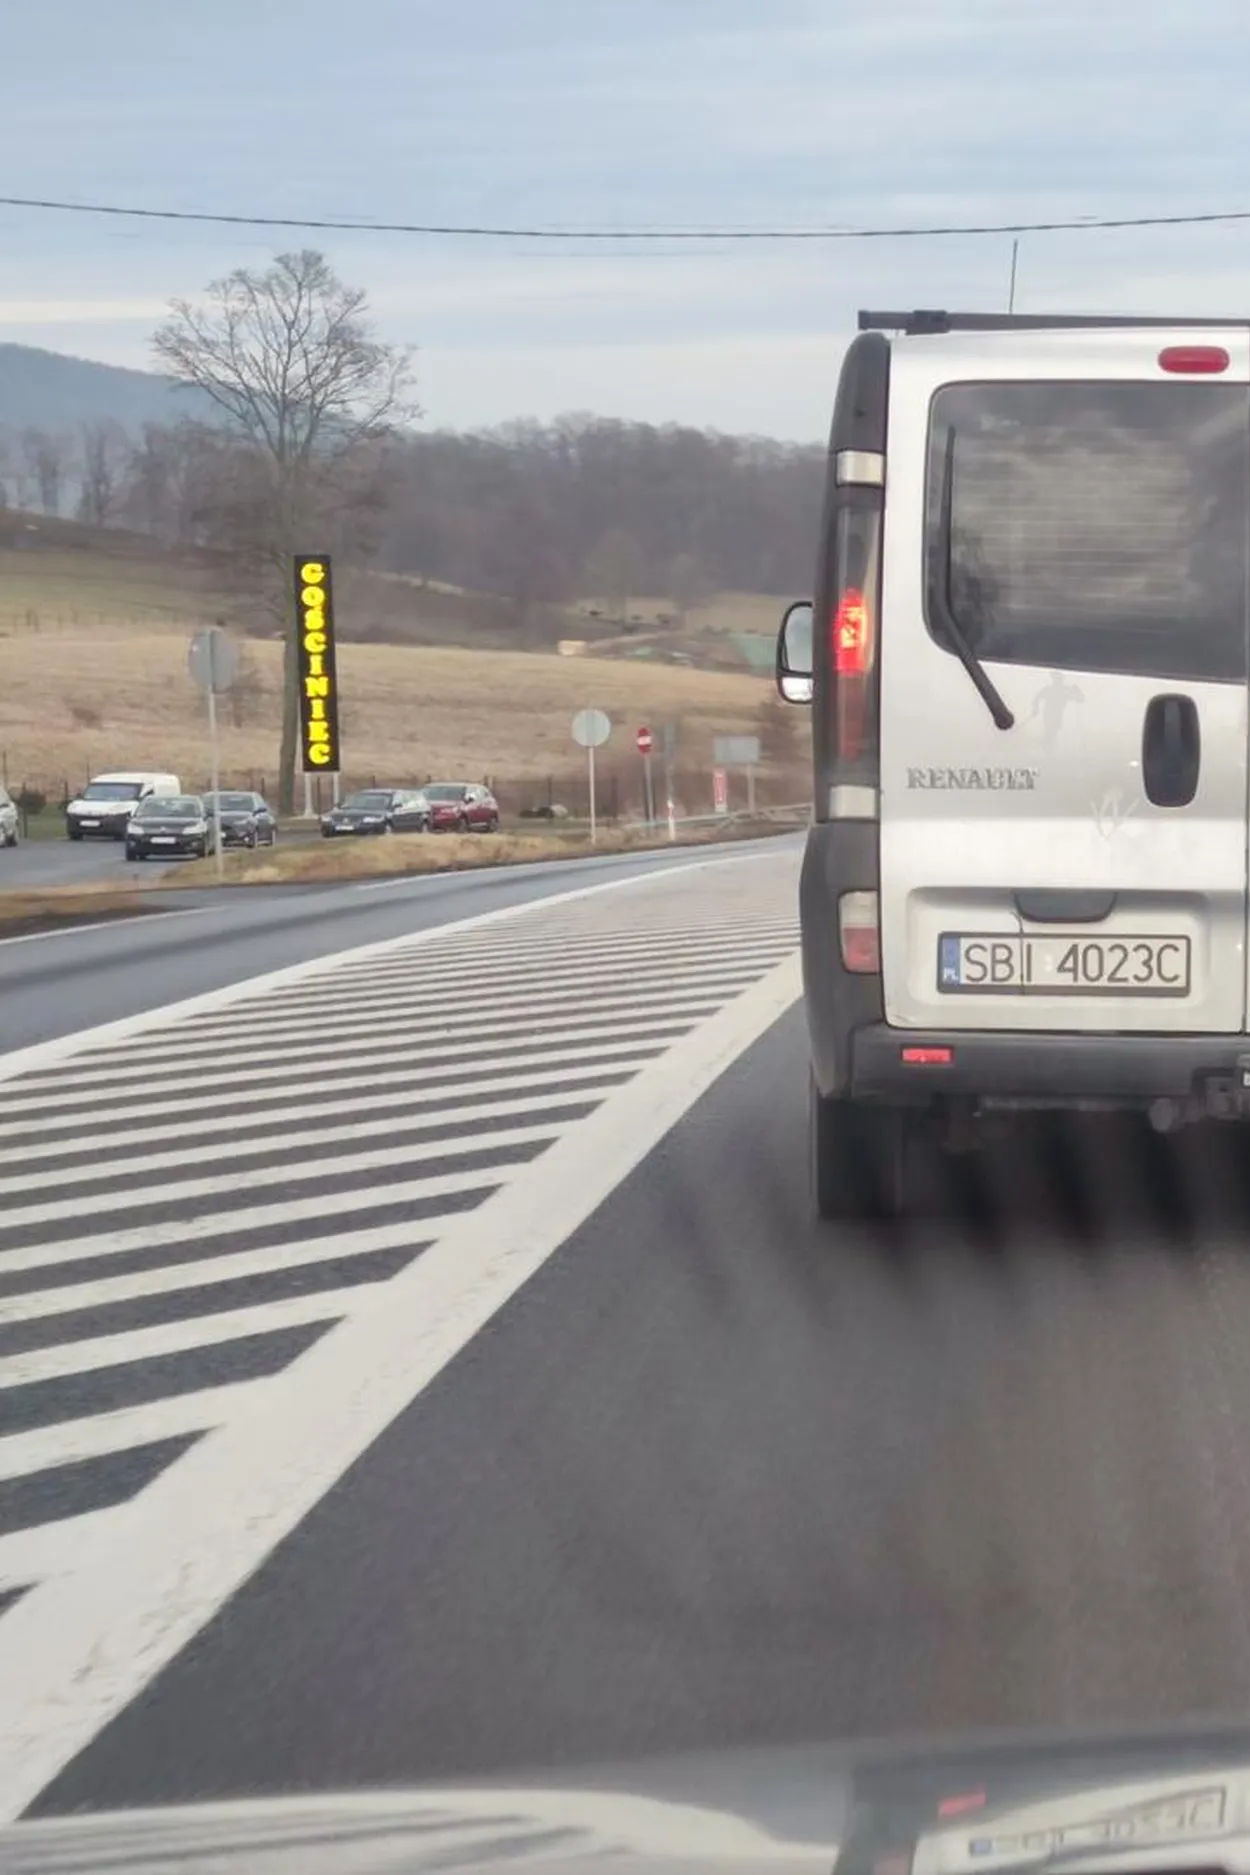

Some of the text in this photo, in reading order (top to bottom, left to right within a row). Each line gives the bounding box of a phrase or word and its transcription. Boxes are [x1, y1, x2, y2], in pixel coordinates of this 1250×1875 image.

[906, 767, 1038, 790] RENAULT
[964, 943, 1180, 983] SBI 4023C
